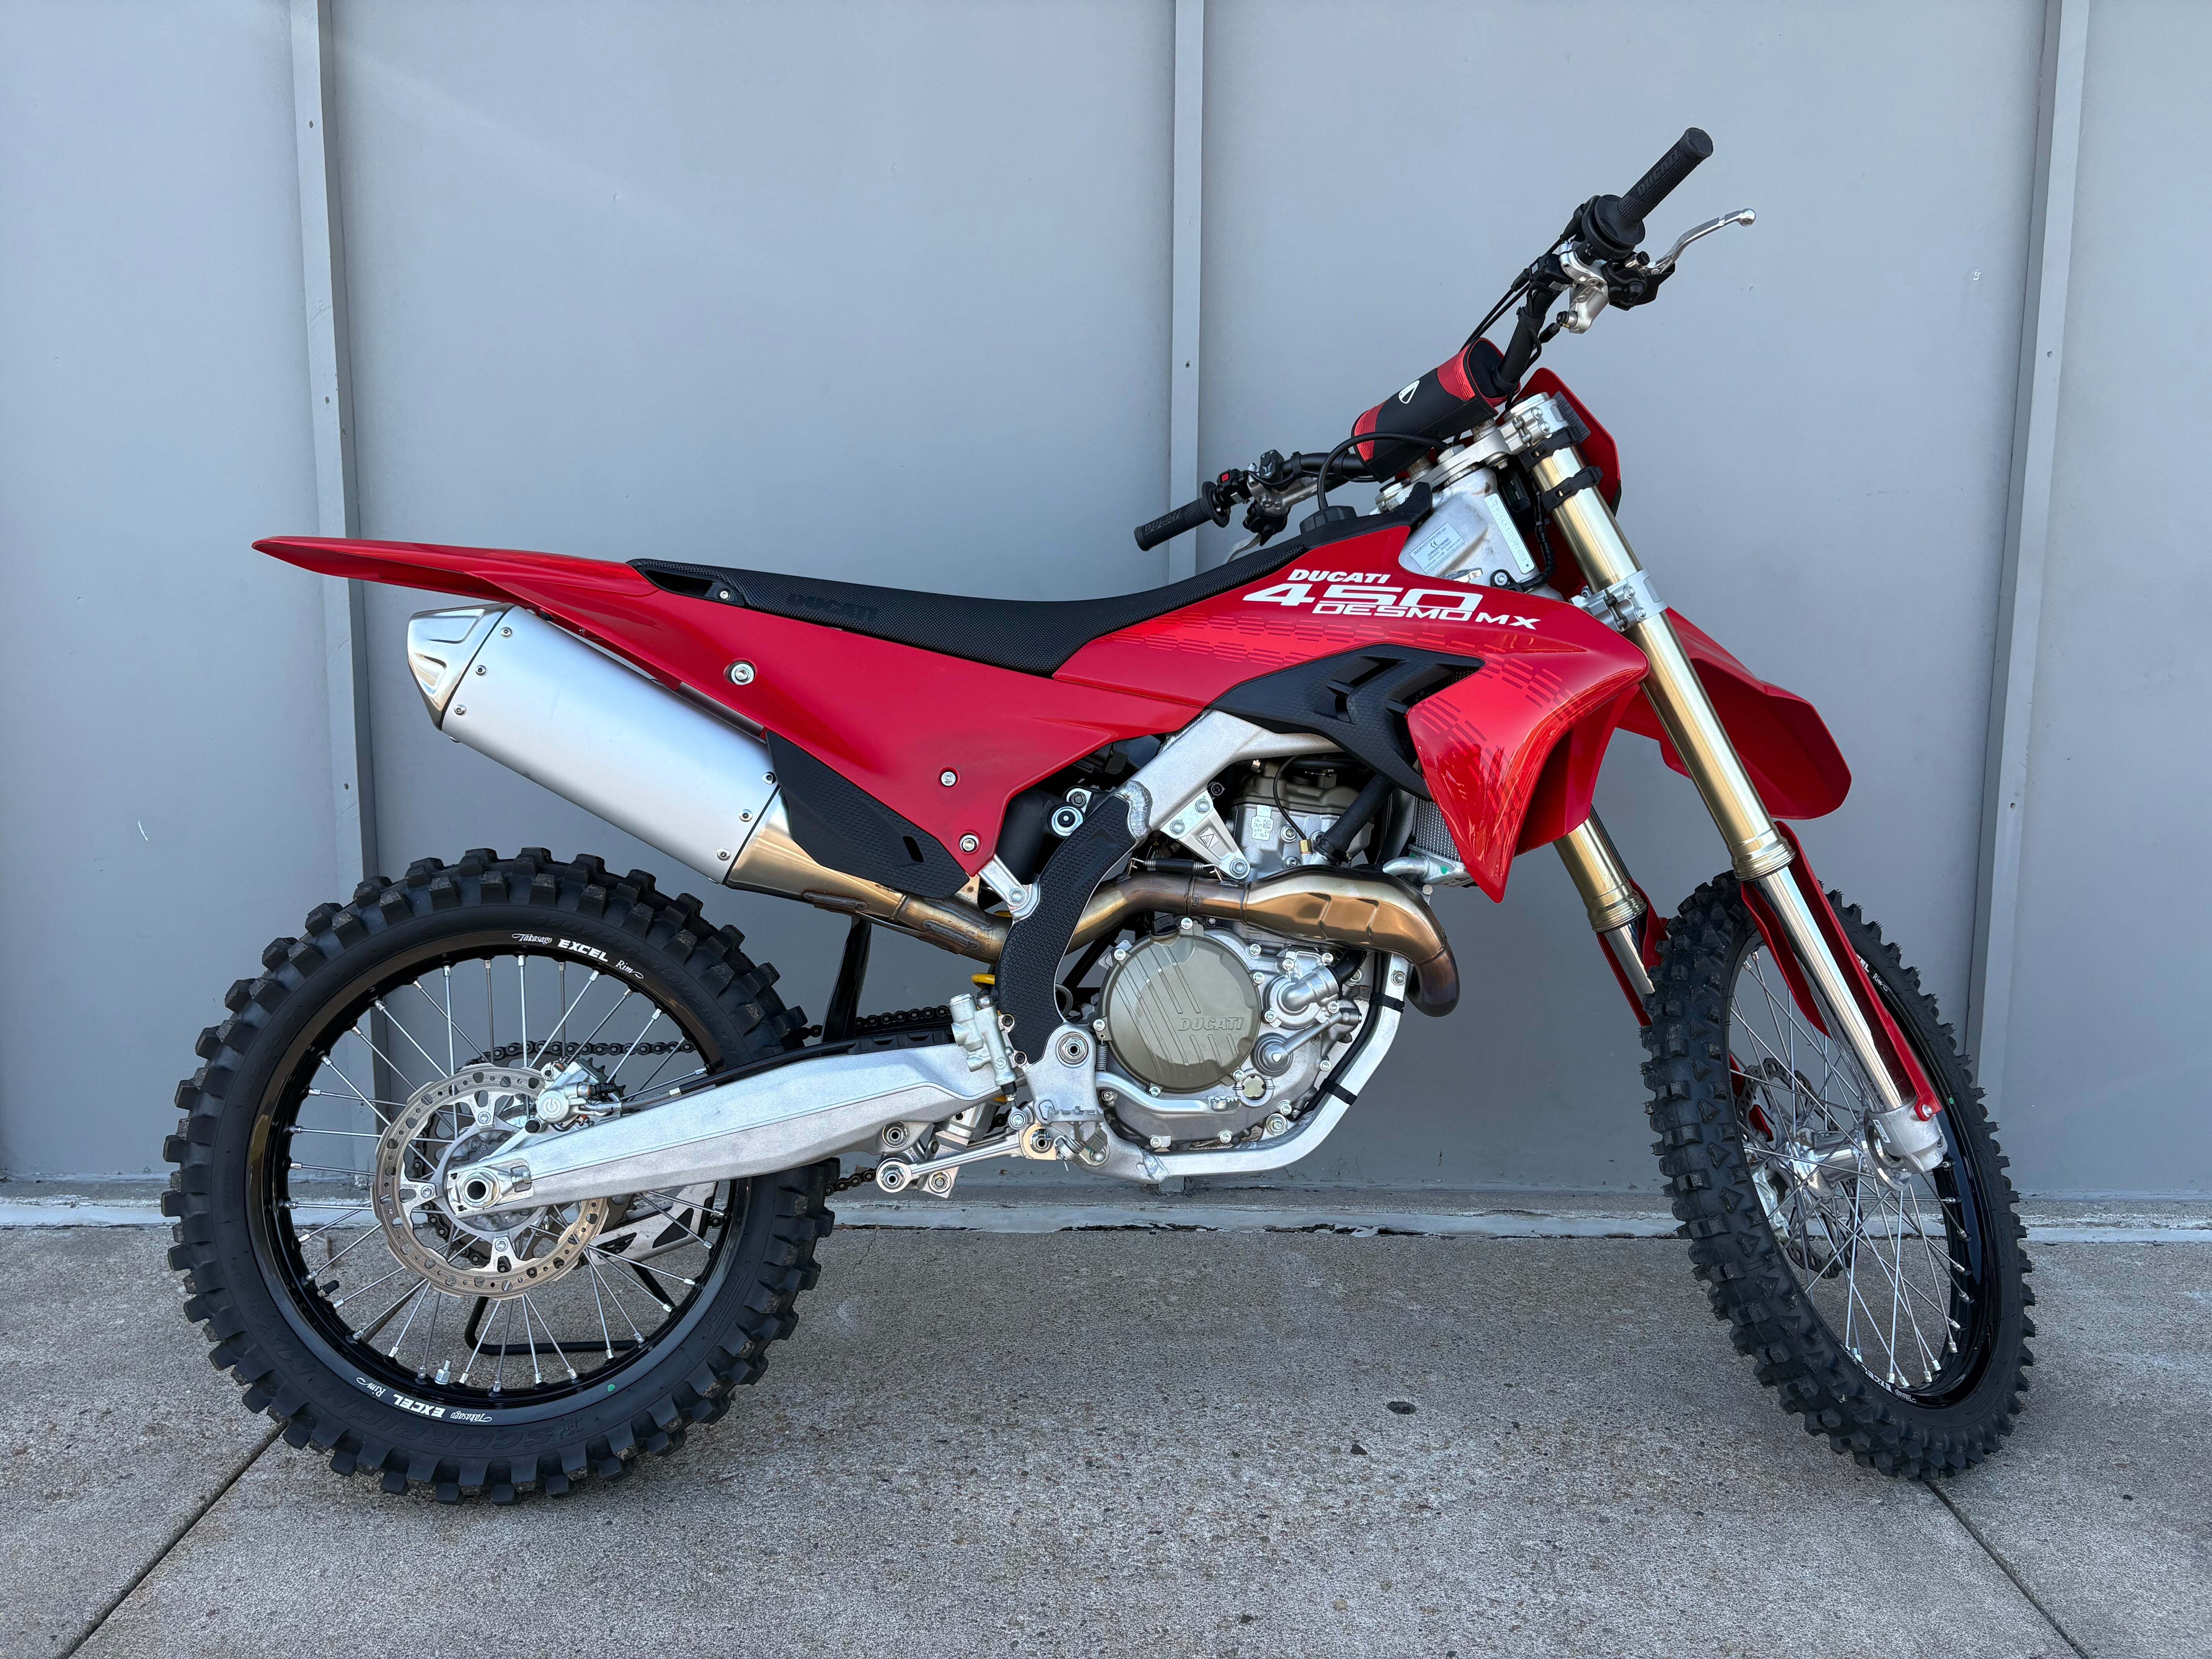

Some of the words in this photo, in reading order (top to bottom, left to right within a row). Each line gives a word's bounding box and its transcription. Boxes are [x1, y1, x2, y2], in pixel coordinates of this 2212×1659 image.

[1637, 149, 1679, 197] DUCATI
[1144, 508, 1182, 534] DUCATI
[1287, 569, 1391, 584] DUCATI
[1243, 583, 1483, 612] 450
[1312, 603, 1475, 622] DESMO
[1475, 612, 1541, 630] MX
[512, 933, 553, 945] Takasago
[557, 938, 608, 962] EXCEL
[615, 960, 644, 979] Rim
[1872, 973, 1888, 992] Rim
[1178, 1017, 1243, 1031] DUCATI
[356, 1377, 386, 1398] Rim
[1862, 1364, 1893, 1393] EXCEL
[393, 1394, 446, 1418] EXCEL
[450, 1410, 492, 1422] Takasago
